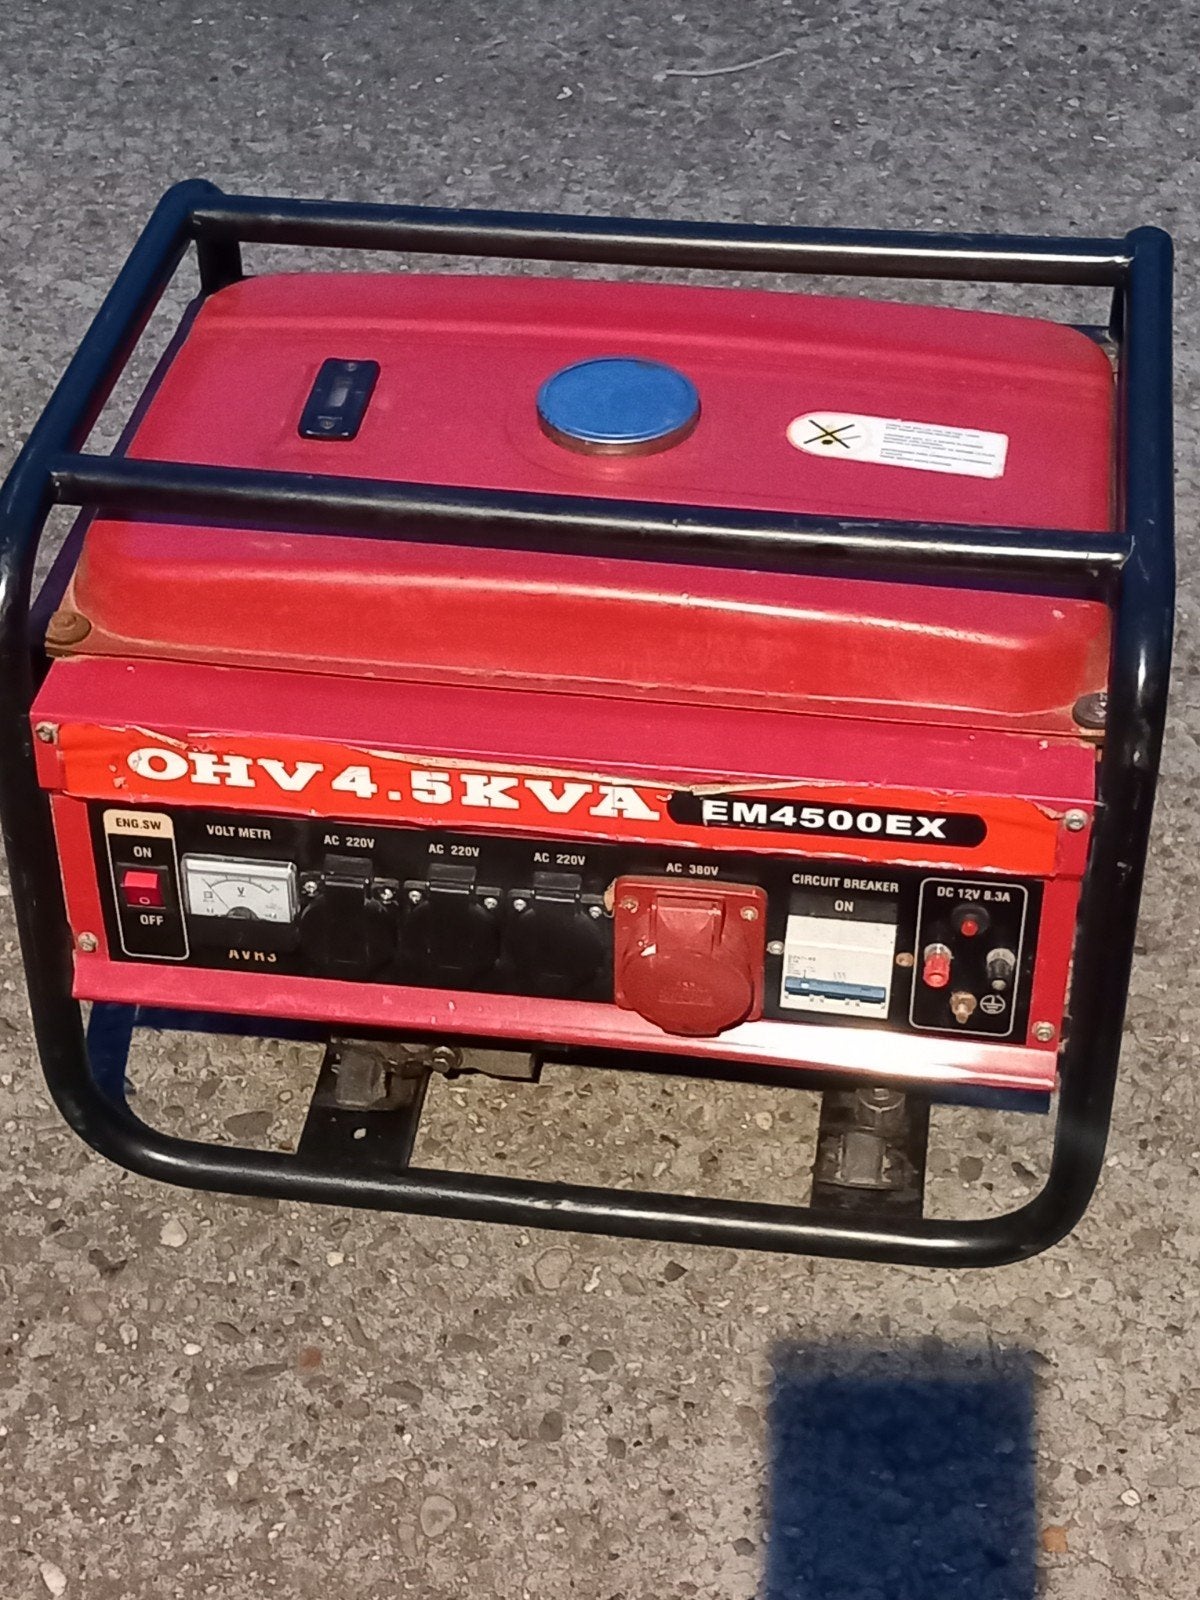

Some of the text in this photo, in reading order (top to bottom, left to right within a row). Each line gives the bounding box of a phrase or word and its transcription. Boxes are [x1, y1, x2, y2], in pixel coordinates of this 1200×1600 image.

[115, 817, 162, 830] ENG.SW
[702, 799, 947, 839] EM4500EX
[206, 825, 272, 840] VOLT METR
[324, 834, 375, 849] AC 220V
[133, 846, 152, 858] ON
[428, 843, 480, 857] AC 220V
[534, 852, 586, 866] AC 220V
[666, 862, 719, 876] AC 380V
[792, 873, 899, 893] CIRCUIT BREAKER
[936, 886, 1011, 903] DC 12V 8.3A
[834, 900, 854, 912] ON
[139, 914, 164, 926] OFF
